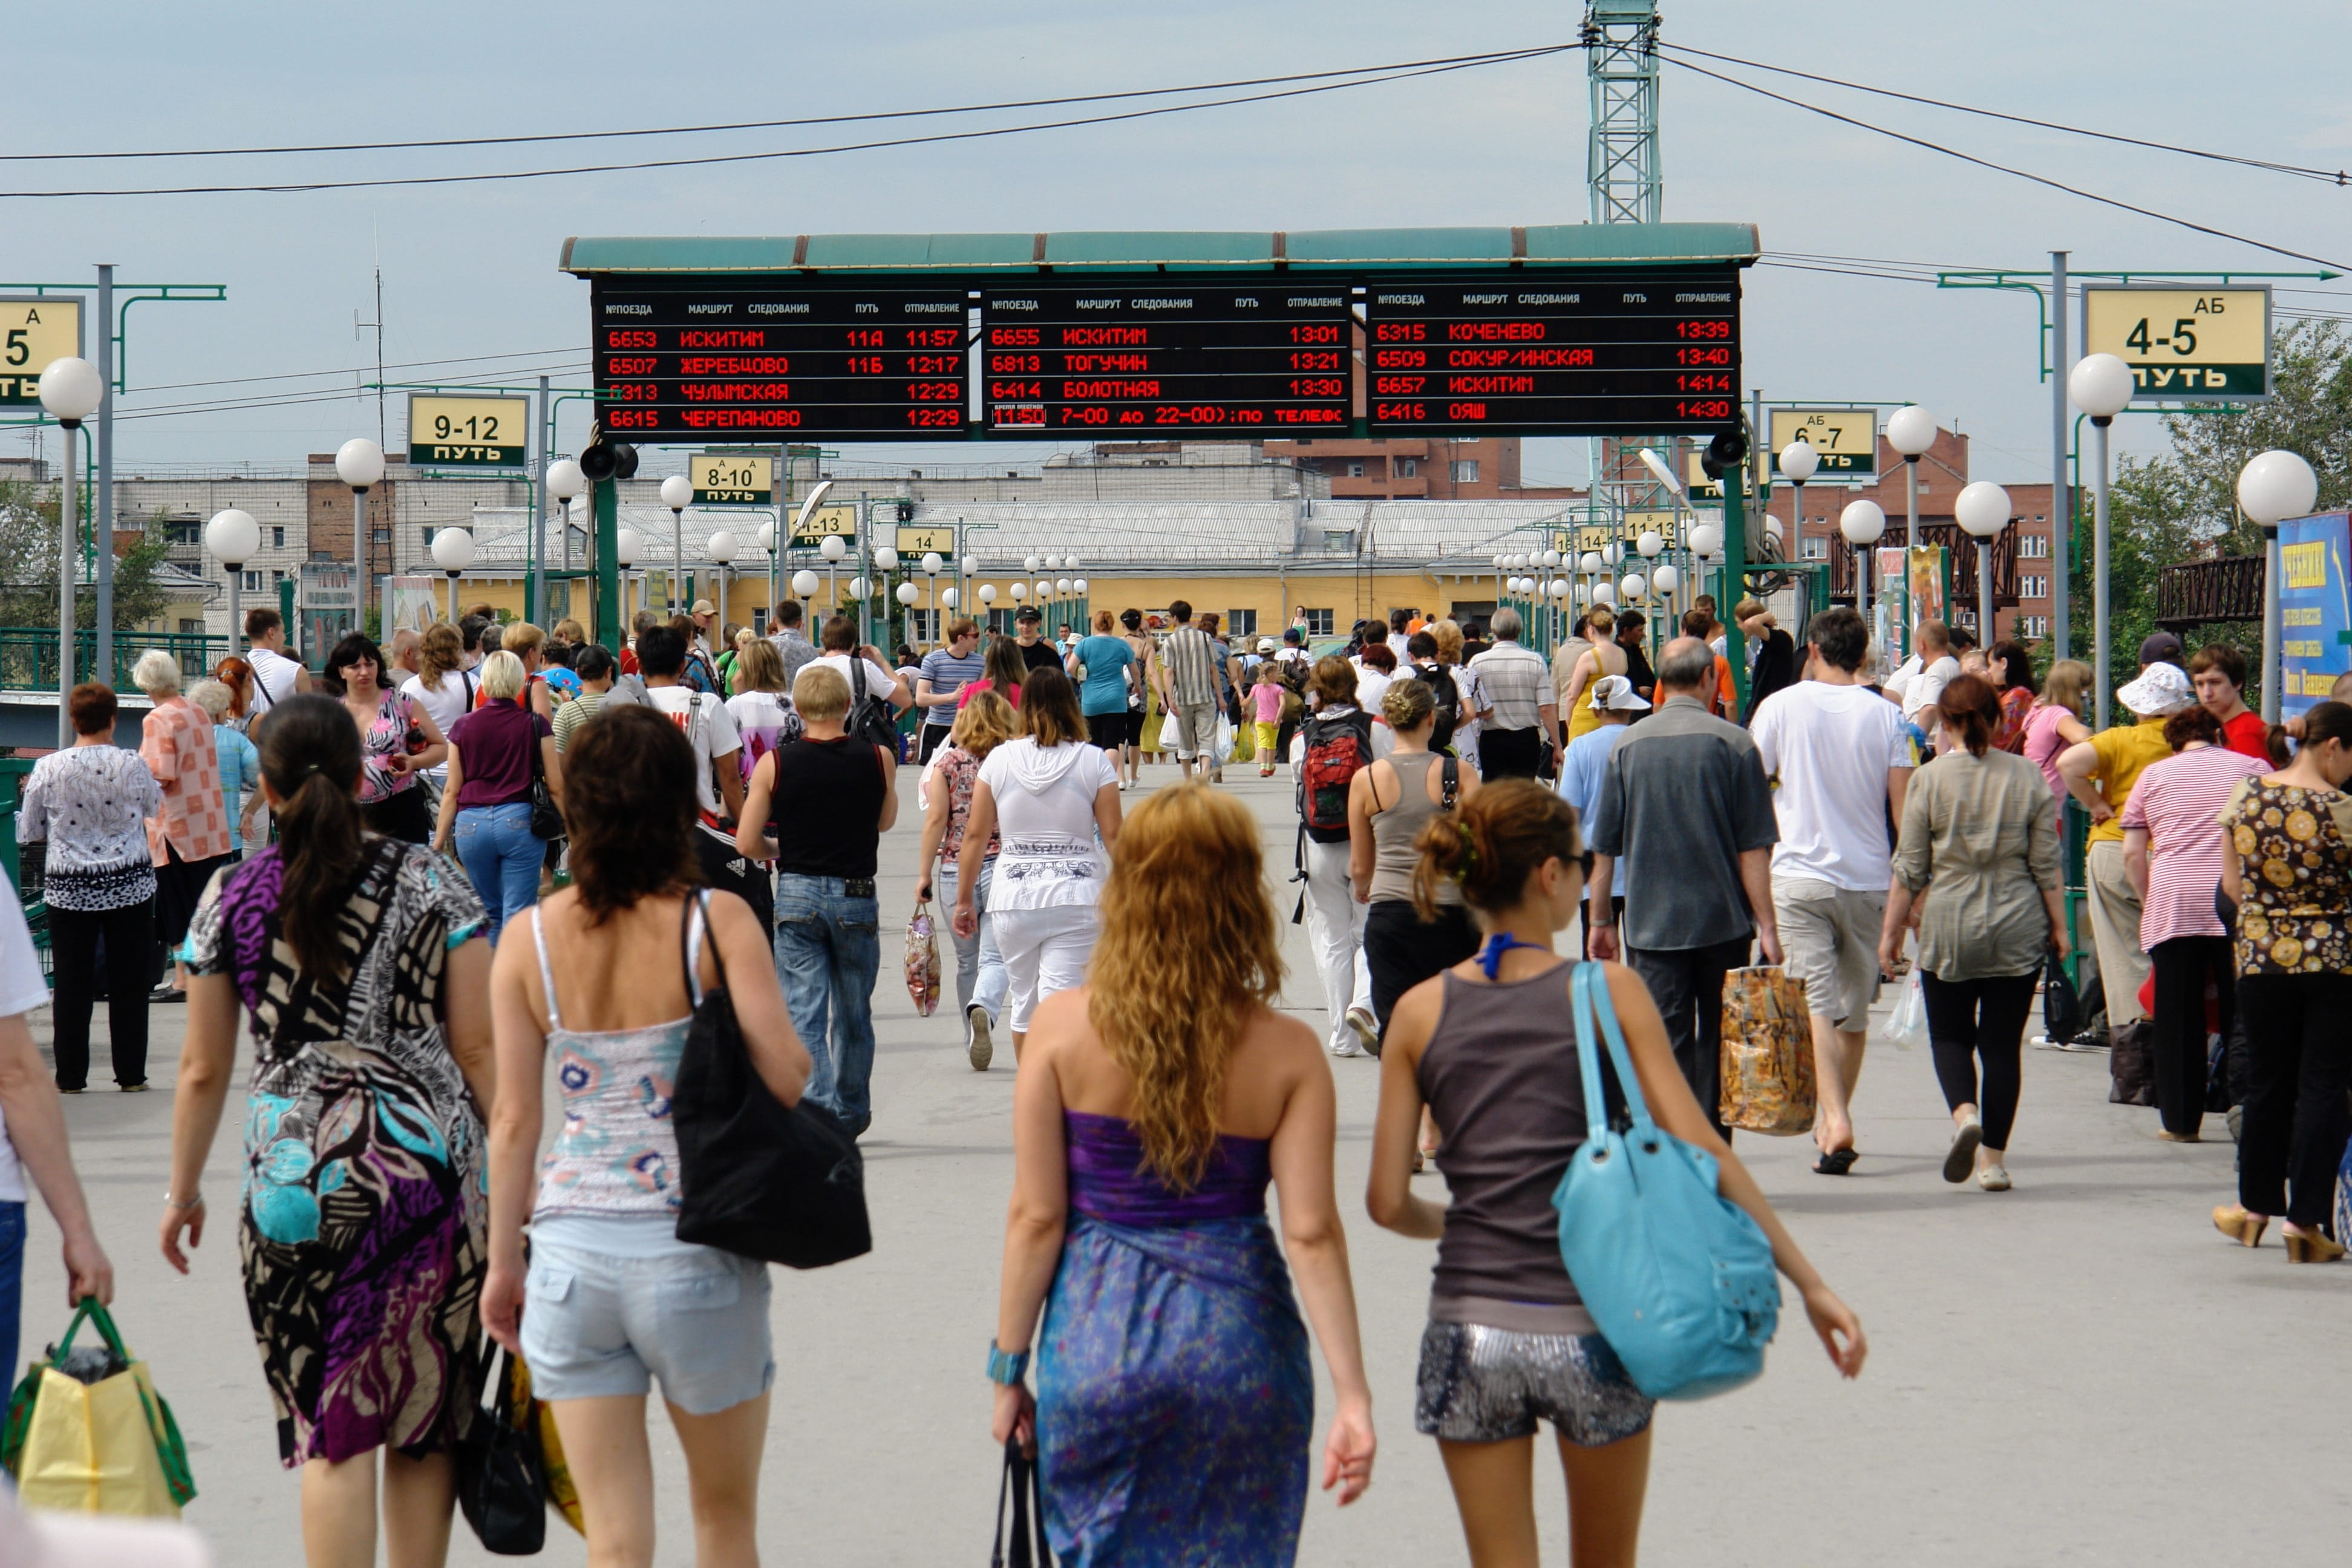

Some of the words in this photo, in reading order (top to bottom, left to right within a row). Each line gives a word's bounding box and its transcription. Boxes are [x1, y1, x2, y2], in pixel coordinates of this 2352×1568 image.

[1076, 299, 1121, 309] МАРШРУТ
[1131, 299, 1193, 310] СЛЕДОВАНИЯ
[1235, 298, 1259, 307] ПУТЬ
[1287, 298, 1342, 307] ОТПРАВЛЕНИЕ
[1463, 295, 1508, 304] МАРШРУТ
[1518, 294, 1579, 305] СЛЕДОВАНИЯ
[1623, 294, 1647, 303] ПУТЬ
[1676, 293, 1731, 303] ОТПРАВЛЕНИЕ
[2194, 298, 2225, 313] АБ
[25, 308, 41, 324] А
[688, 304, 733, 313] МАРШРУТ
[748, 304, 809, 315] СЛЕДОВАНИЯ
[855, 304, 879, 313] ПУТЬ
[904, 304, 959, 313] ОТПРАВЛЕНИЕ
[609, 331, 657, 348] 6653
[680, 330, 764, 347] ИСКИТИМ
[847, 330, 883, 347] 11А
[906, 330, 958, 347] 11:57
[991, 328, 1040, 345] 6655
[1063, 328, 1147, 345] ИСКИТИМ
[1290, 326, 1339, 342] 13:01
[1377, 324, 1426, 341] 6315
[1449, 322, 1545, 341] КОЧЕНЕВО
[1677, 321, 1730, 338] 13:39
[2126, 317, 2197, 356] 4-5
[609, 358, 658, 374] 6507
[681, 357, 789, 374] ЖЕРЕБЦОВО
[848, 356, 883, 373] 11Б
[907, 356, 959, 373] 12:17
[991, 355, 1040, 372] 6813
[1064, 354, 1148, 371] ТОГУЧИН
[1290, 353, 1338, 370] 13:21
[1377, 350, 1426, 367] 6509
[1449, 349, 1593, 367] СОКУР/ИНСКАЯ
[1677, 348, 1730, 365] 13:40
[1377, 377, 1426, 394] 6657
[1449, 376, 1534, 393] ИСКИТИМ
[1677, 374, 1730, 391] 14:14
[2131, 368, 2227, 387] ПУТЬ
[681, 384, 789, 400] ЧУЛЫМСКАЯ
[907, 382, 959, 400] 12:29
[991, 382, 1041, 399] 6414
[1063, 381, 1160, 398] БОЛОТНАЯ
[1290, 379, 1342, 396] 13:30
[610, 411, 658, 427] 6615
[681, 410, 801, 427] ЧЕРЕПАНОВО
[907, 409, 959, 426] 12:29
[993, 408, 1046, 425] 11:50
[1062, 407, 1109, 424] 7-00
[1377, 403, 1426, 420] 6416
[1449, 402, 1486, 419] ОЯШ
[1677, 401, 1729, 417] 14:30
[435, 415, 498, 440] 9-12
[1807, 416, 1825, 425] АБ
[434, 446, 501, 460] ПУТЬ
[708, 469, 753, 486] 8-10
[707, 491, 755, 501] ПУТЬ
[804, 536, 824, 545] ПУ
[915, 537, 933, 549] 14
